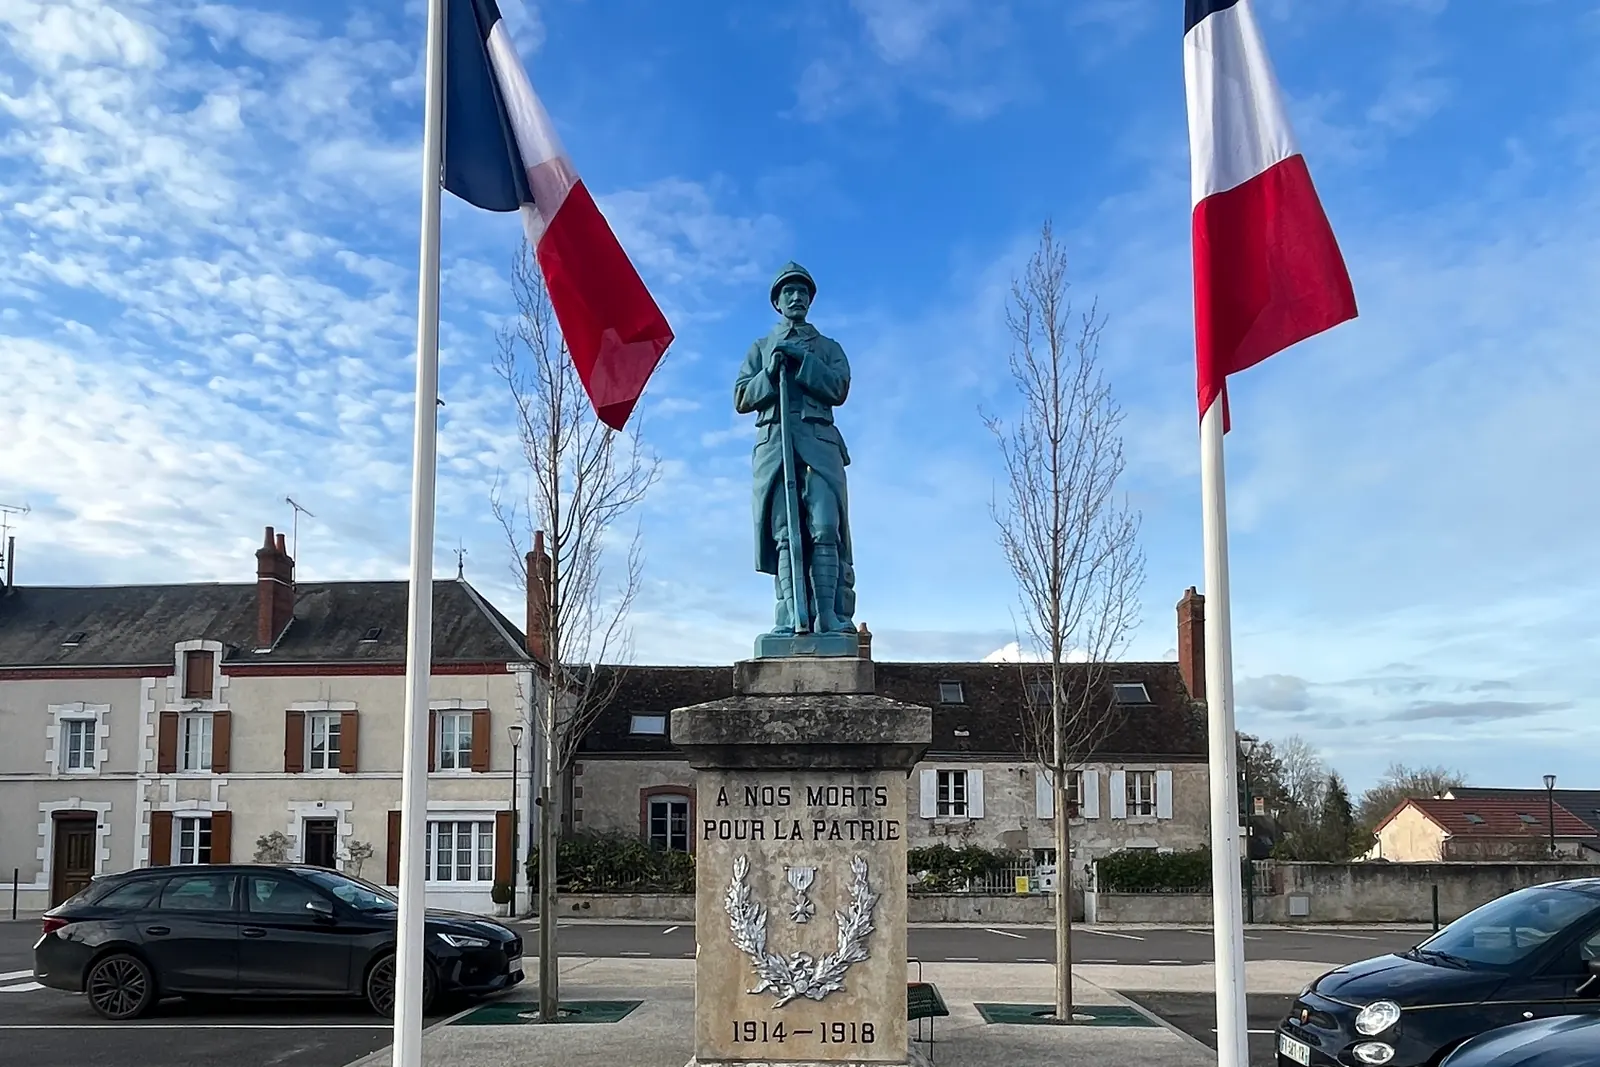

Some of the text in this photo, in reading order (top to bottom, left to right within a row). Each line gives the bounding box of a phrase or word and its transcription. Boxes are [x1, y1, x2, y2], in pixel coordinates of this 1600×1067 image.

[716, 785, 888, 807] A NOS MORTS
[703, 819, 900, 841] POUR LA PATRIE
